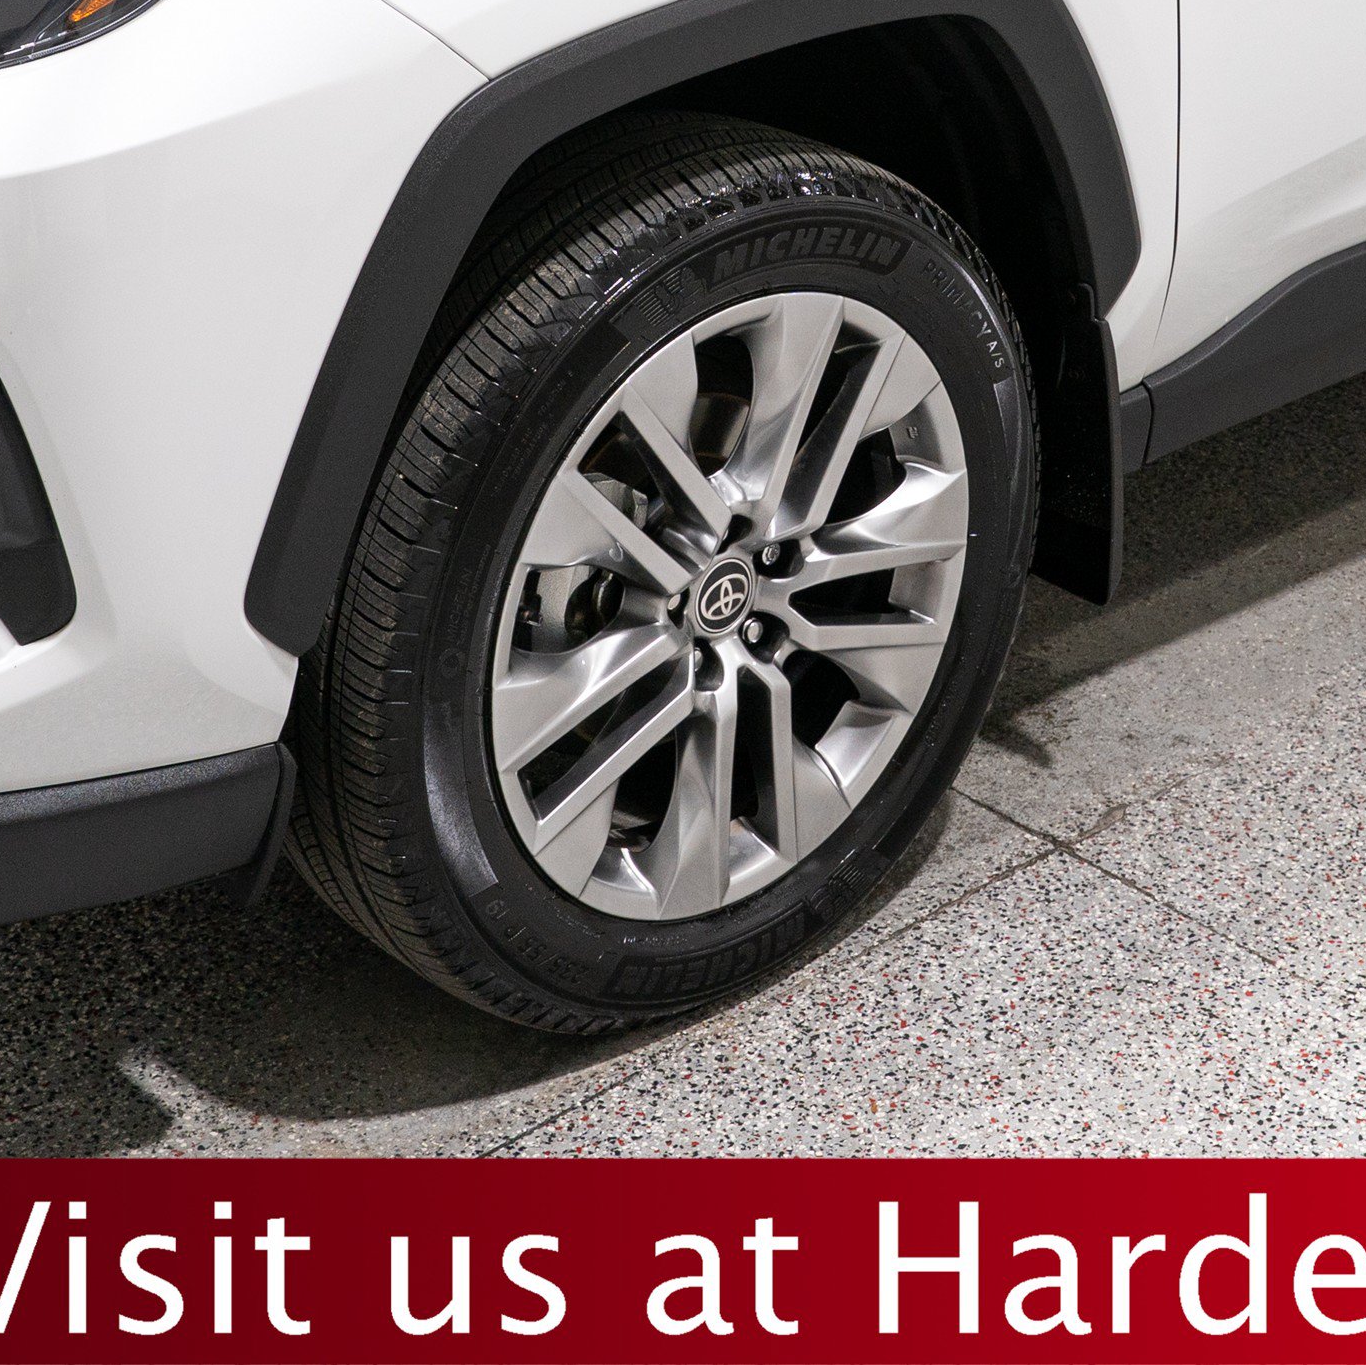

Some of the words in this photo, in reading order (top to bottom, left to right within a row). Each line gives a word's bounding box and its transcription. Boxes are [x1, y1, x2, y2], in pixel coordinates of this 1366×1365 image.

[711, 226, 903, 283] MICHELIN
[923, 259, 992, 338] PRIMACY
[986, 340, 1005, 368] A/S
